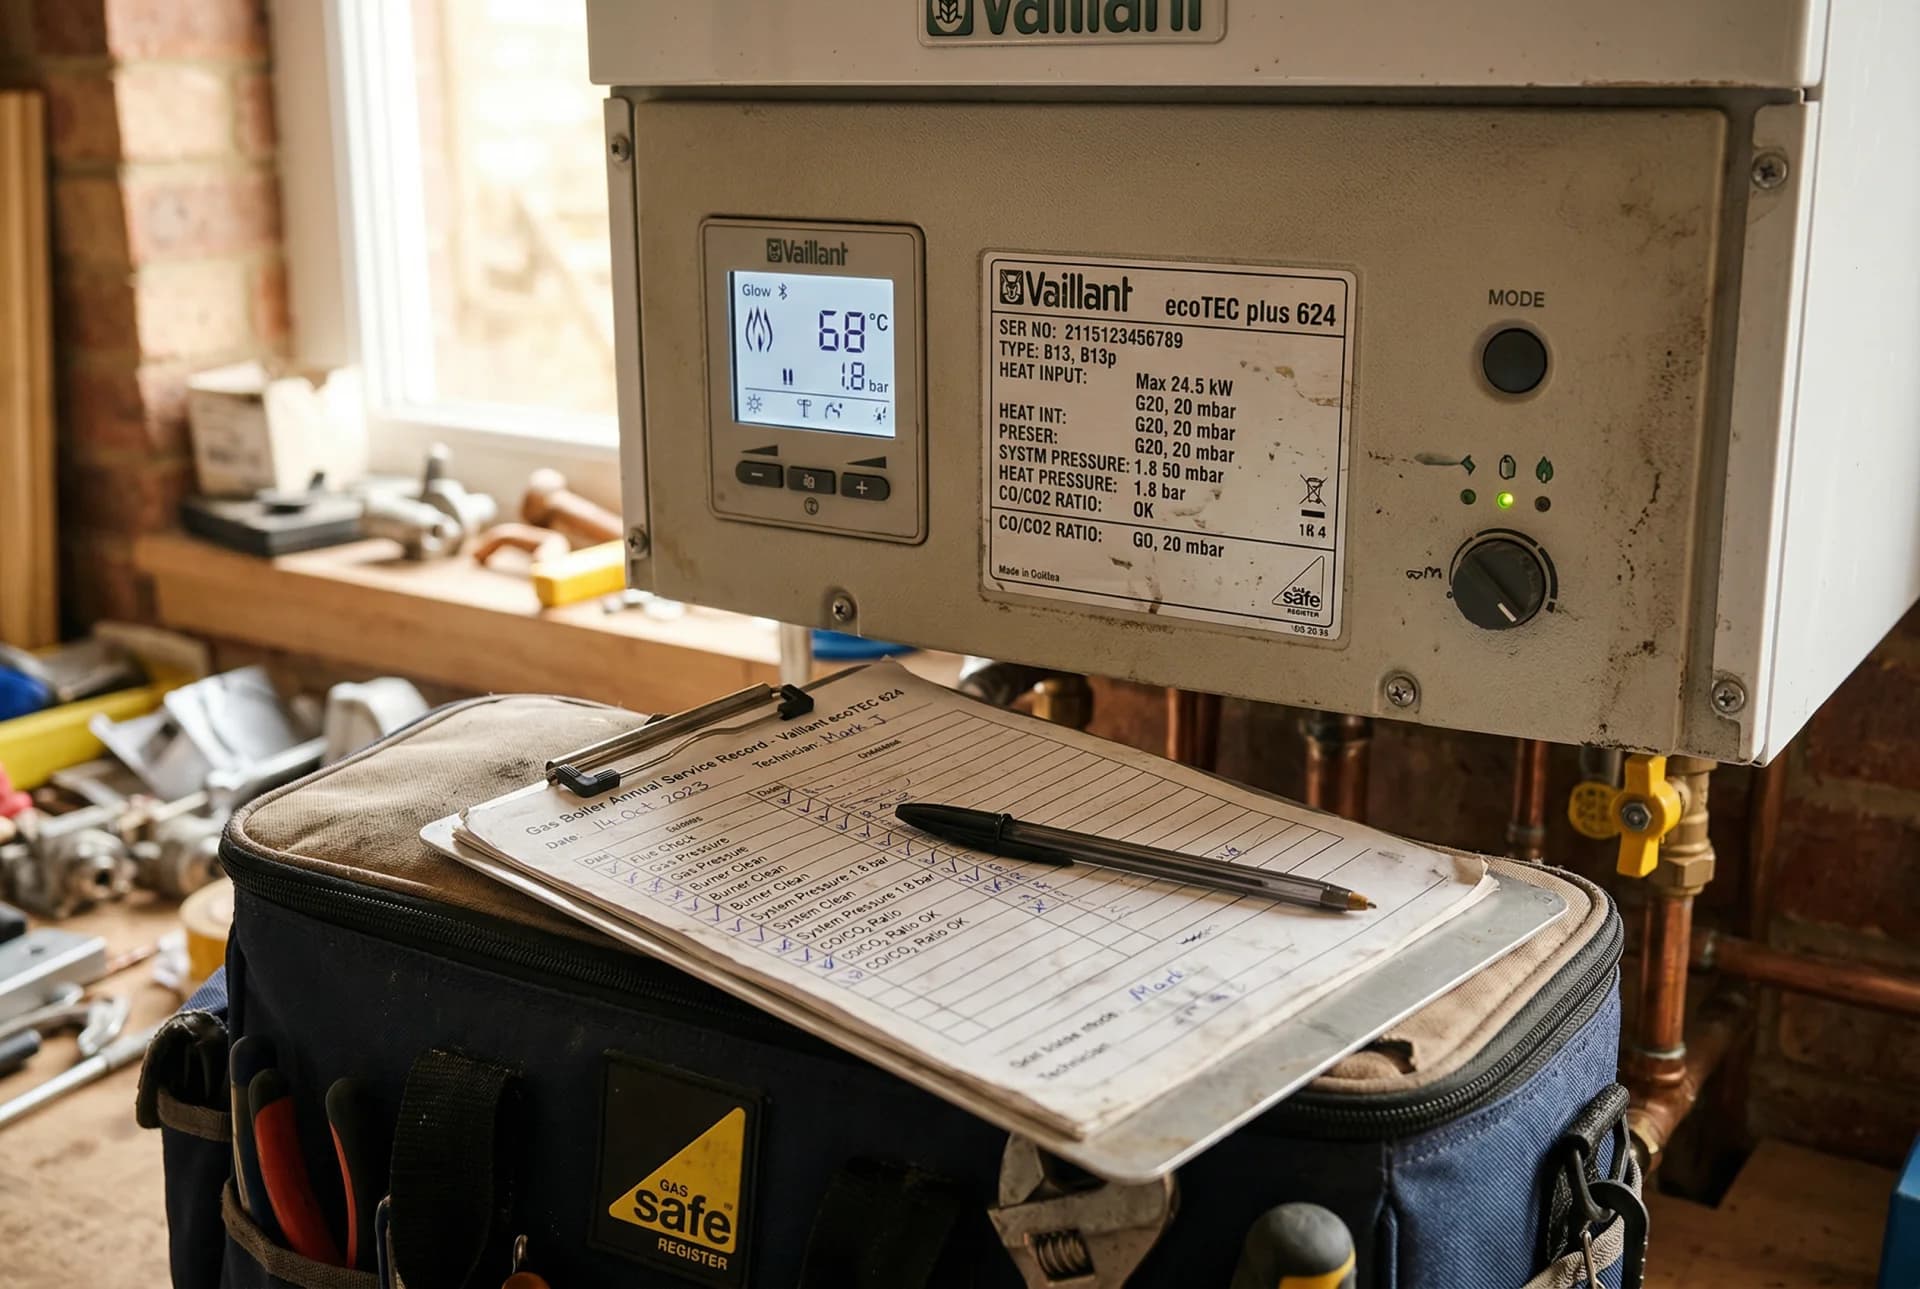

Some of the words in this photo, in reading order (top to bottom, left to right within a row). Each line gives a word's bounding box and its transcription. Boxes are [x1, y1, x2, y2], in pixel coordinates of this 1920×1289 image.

[782, 240, 848, 266] Vaillant
[742, 284, 771, 297] Glow
[1025, 270, 1133, 313] Vaillant
[1488, 289, 1545, 308] MODE
[1165, 297, 1239, 321] ecoTEC
[1246, 300, 1290, 326] plus
[1296, 303, 1336, 326] 624
[818, 310, 865, 353] 68
[999, 320, 1027, 338] SER
[1031, 322, 1056, 339] NO:
[1065, 324, 1183, 348] 2115123456789
[999, 341, 1039, 360] TYPE:
[1044, 344, 1075, 364] B13,
[1080, 347, 1117, 368] B13p
[841, 362, 865, 391] 1.8
[869, 380, 889, 393] bar
[999, 362, 1035, 380] HEAT
[1039, 364, 1087, 384] INPUT:
[1136, 373, 1166, 391] Max
[1170, 375, 1204, 394] 24.5
[1209, 378, 1233, 396] kW
[999, 404, 1034, 421] HEAT
[1039, 406, 1066, 424] INT:
[1136, 395, 1169, 419] G20,
[1174, 398, 1192, 416] 20
[1197, 400, 1236, 419] mbar
[999, 425, 1058, 444] PRESER:
[1135, 417, 1169, 440] G20,
[1173, 420, 1192, 437] 20
[1196, 422, 1235, 441] mbar
[1135, 438, 1168, 460] G20,
[1172, 441, 1191, 458] 20
[1195, 443, 1235, 463] mbar
[1052, 450, 1130, 473] PRESSURE:
[1134, 460, 1157, 476] 1.8
[1161, 462, 1181, 478] 50
[1185, 464, 1224, 484] mbar
[999, 465, 1034, 483] HEAT
[1039, 469, 1117, 493] PRESSURE:
[1134, 481, 1156, 497] 1.8
[1162, 483, 1185, 501] bar
[999, 485, 1051, 505] CO/CO2
[1056, 492, 1102, 512] RATIO:
[1133, 501, 1154, 519] OK
[999, 515, 1051, 536] CO/CO2
[1056, 522, 1102, 543] RATIO:
[1163, 535, 1182, 551] 20
[1186, 537, 1224, 558] mbar
[1022, 568, 1029, 577] in
[1283, 590, 1321, 608] safe
[819, 723, 865, 744] Mark
[526, 821, 558, 836] Gas
[559, 801, 606, 824] Boiler
[609, 780, 662, 805] Annual
[661, 761, 718, 784] Service
[718, 741, 768, 763] Record
[829, 699, 879, 722] ecoTEC
[878, 688, 904, 702] 624
[752, 741, 822, 769] Technician:
[619, 802, 657, 821] Oct
[661, 781, 710, 805] 2023
[630, 847, 659, 865] Flue
[658, 834, 697, 853] Check
[649, 859, 676, 873] Gas
[678, 836, 730, 860] Pressure
[670, 867, 697, 881] Gas
[698, 845, 750, 870] Pressure
[689, 871, 729, 891] Burner
[731, 854, 768, 873] Clean
[709, 880, 749, 901] Burner
[750, 863, 788, 882] Clean
[730, 890, 771, 911] Burner
[772, 872, 810, 892] Clean
[751, 895, 797, 922] System
[799, 873, 848, 900] Pressure
[869, 855, 890, 869] bar
[773, 902, 826, 931] System
[827, 890, 857, 907] Clean
[797, 914, 843, 941] System
[845, 892, 896, 919] Pressure
[895, 882, 916, 894] 1.8
[916, 872, 936, 886] bar
[870, 908, 903, 927] Ratio
[888, 920, 919, 939] Ratio
[919, 909, 941, 924] OK
[916, 929, 948, 948] Ratio
[946, 917, 970, 932] OK
[660, 1179, 688, 1197] GAS
[633, 1188, 732, 1245] safe
[657, 1237, 728, 1271] REGISTER
